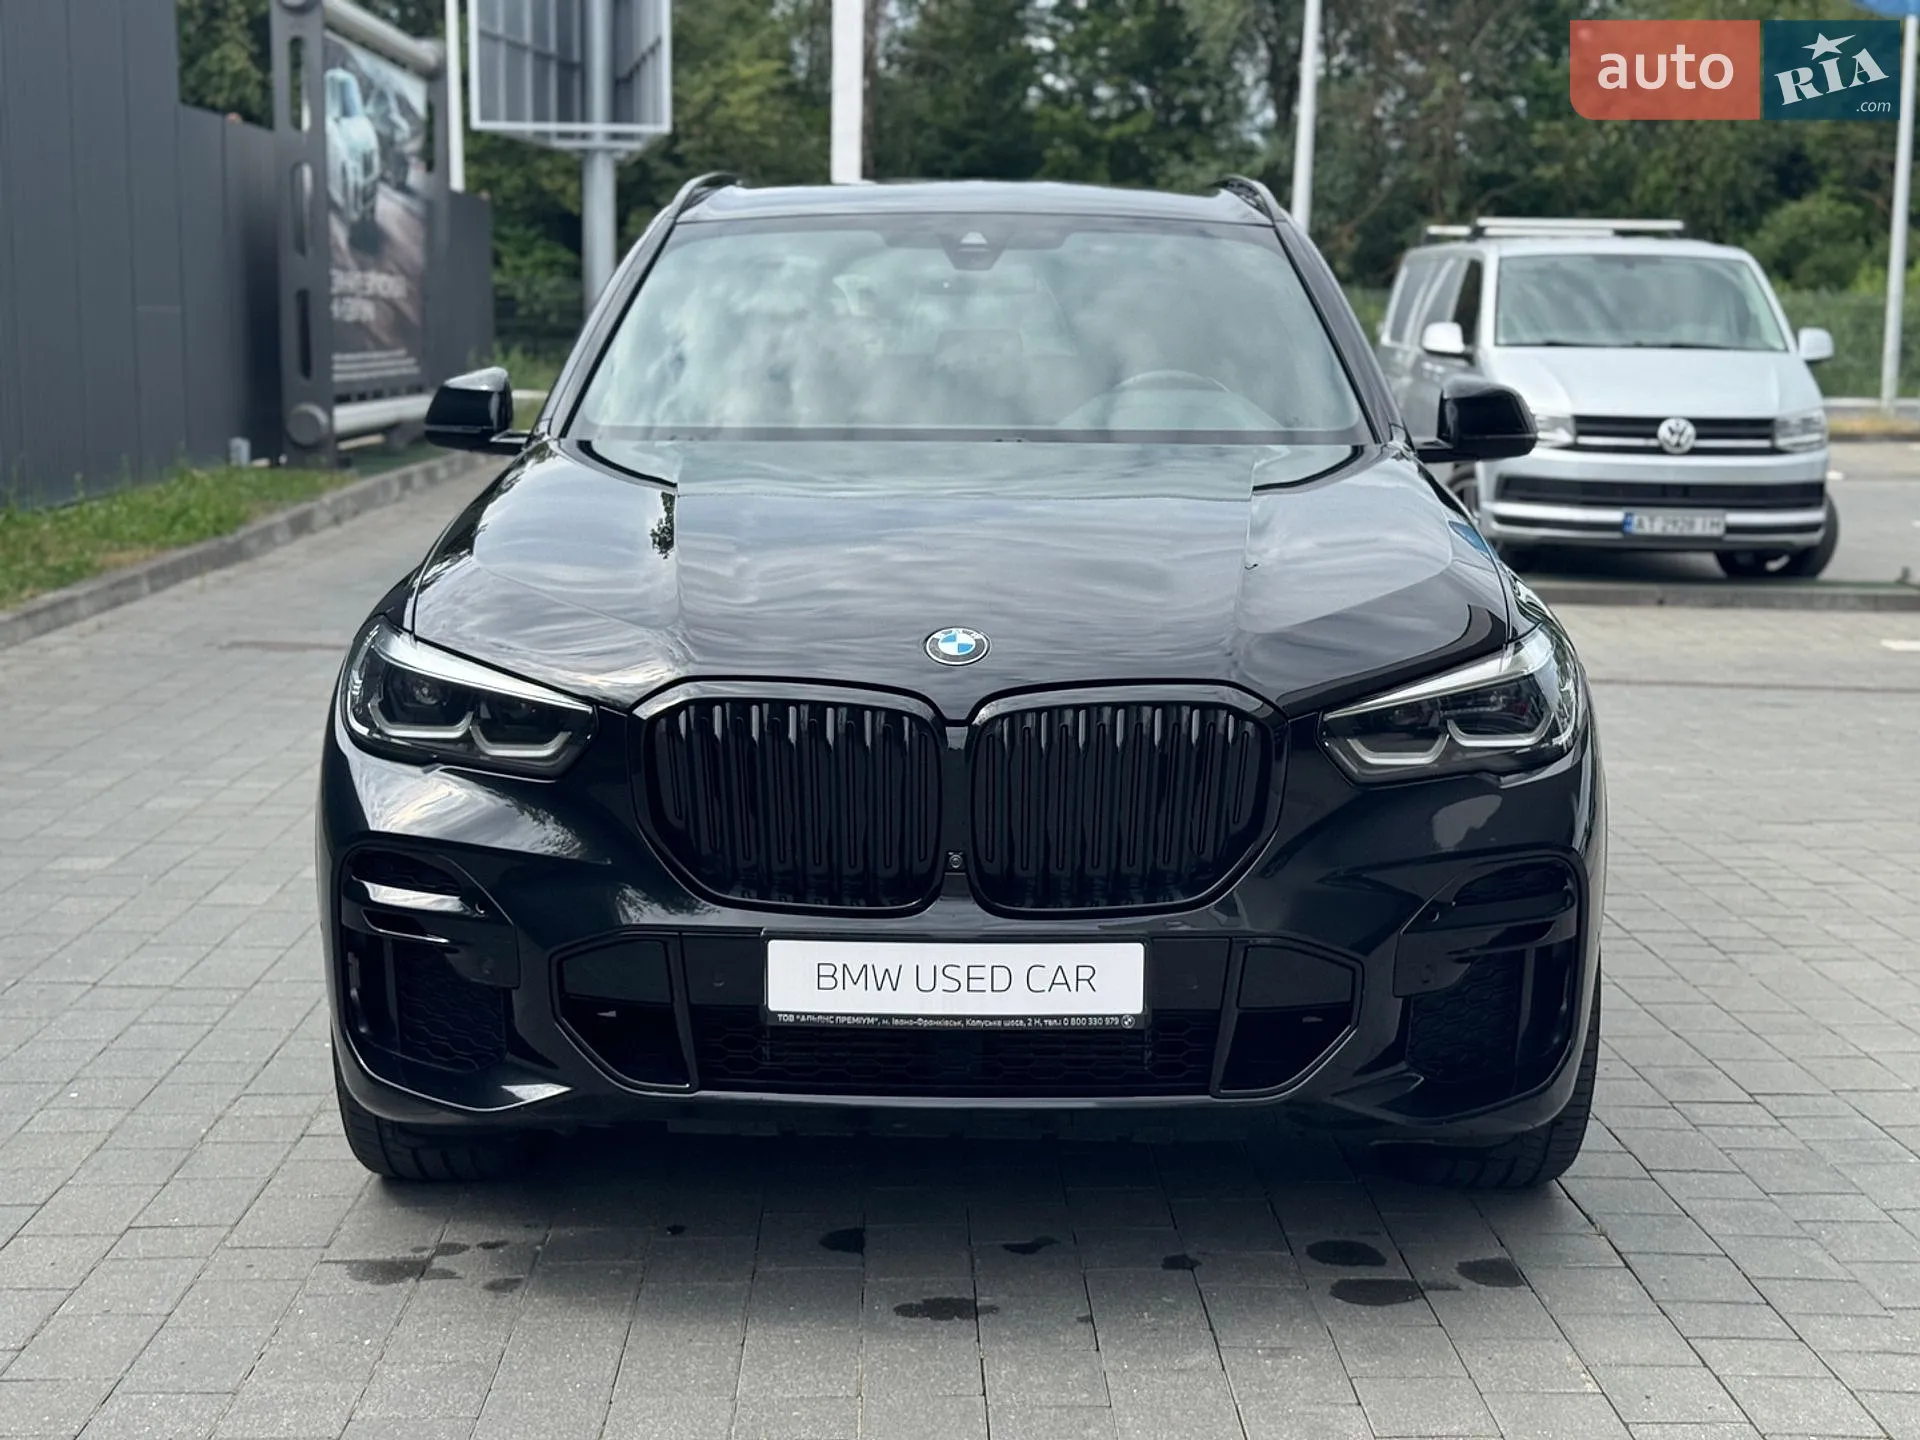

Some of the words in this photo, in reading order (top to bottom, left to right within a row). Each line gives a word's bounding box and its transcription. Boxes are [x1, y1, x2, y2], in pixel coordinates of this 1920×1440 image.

[816, 962, 902, 992] BMW
[915, 964, 1013, 993] USED
[1026, 964, 1097, 993] CAR
[1062, 1017, 1069, 1026] 0
[1070, 1016, 1087, 1026] 800
